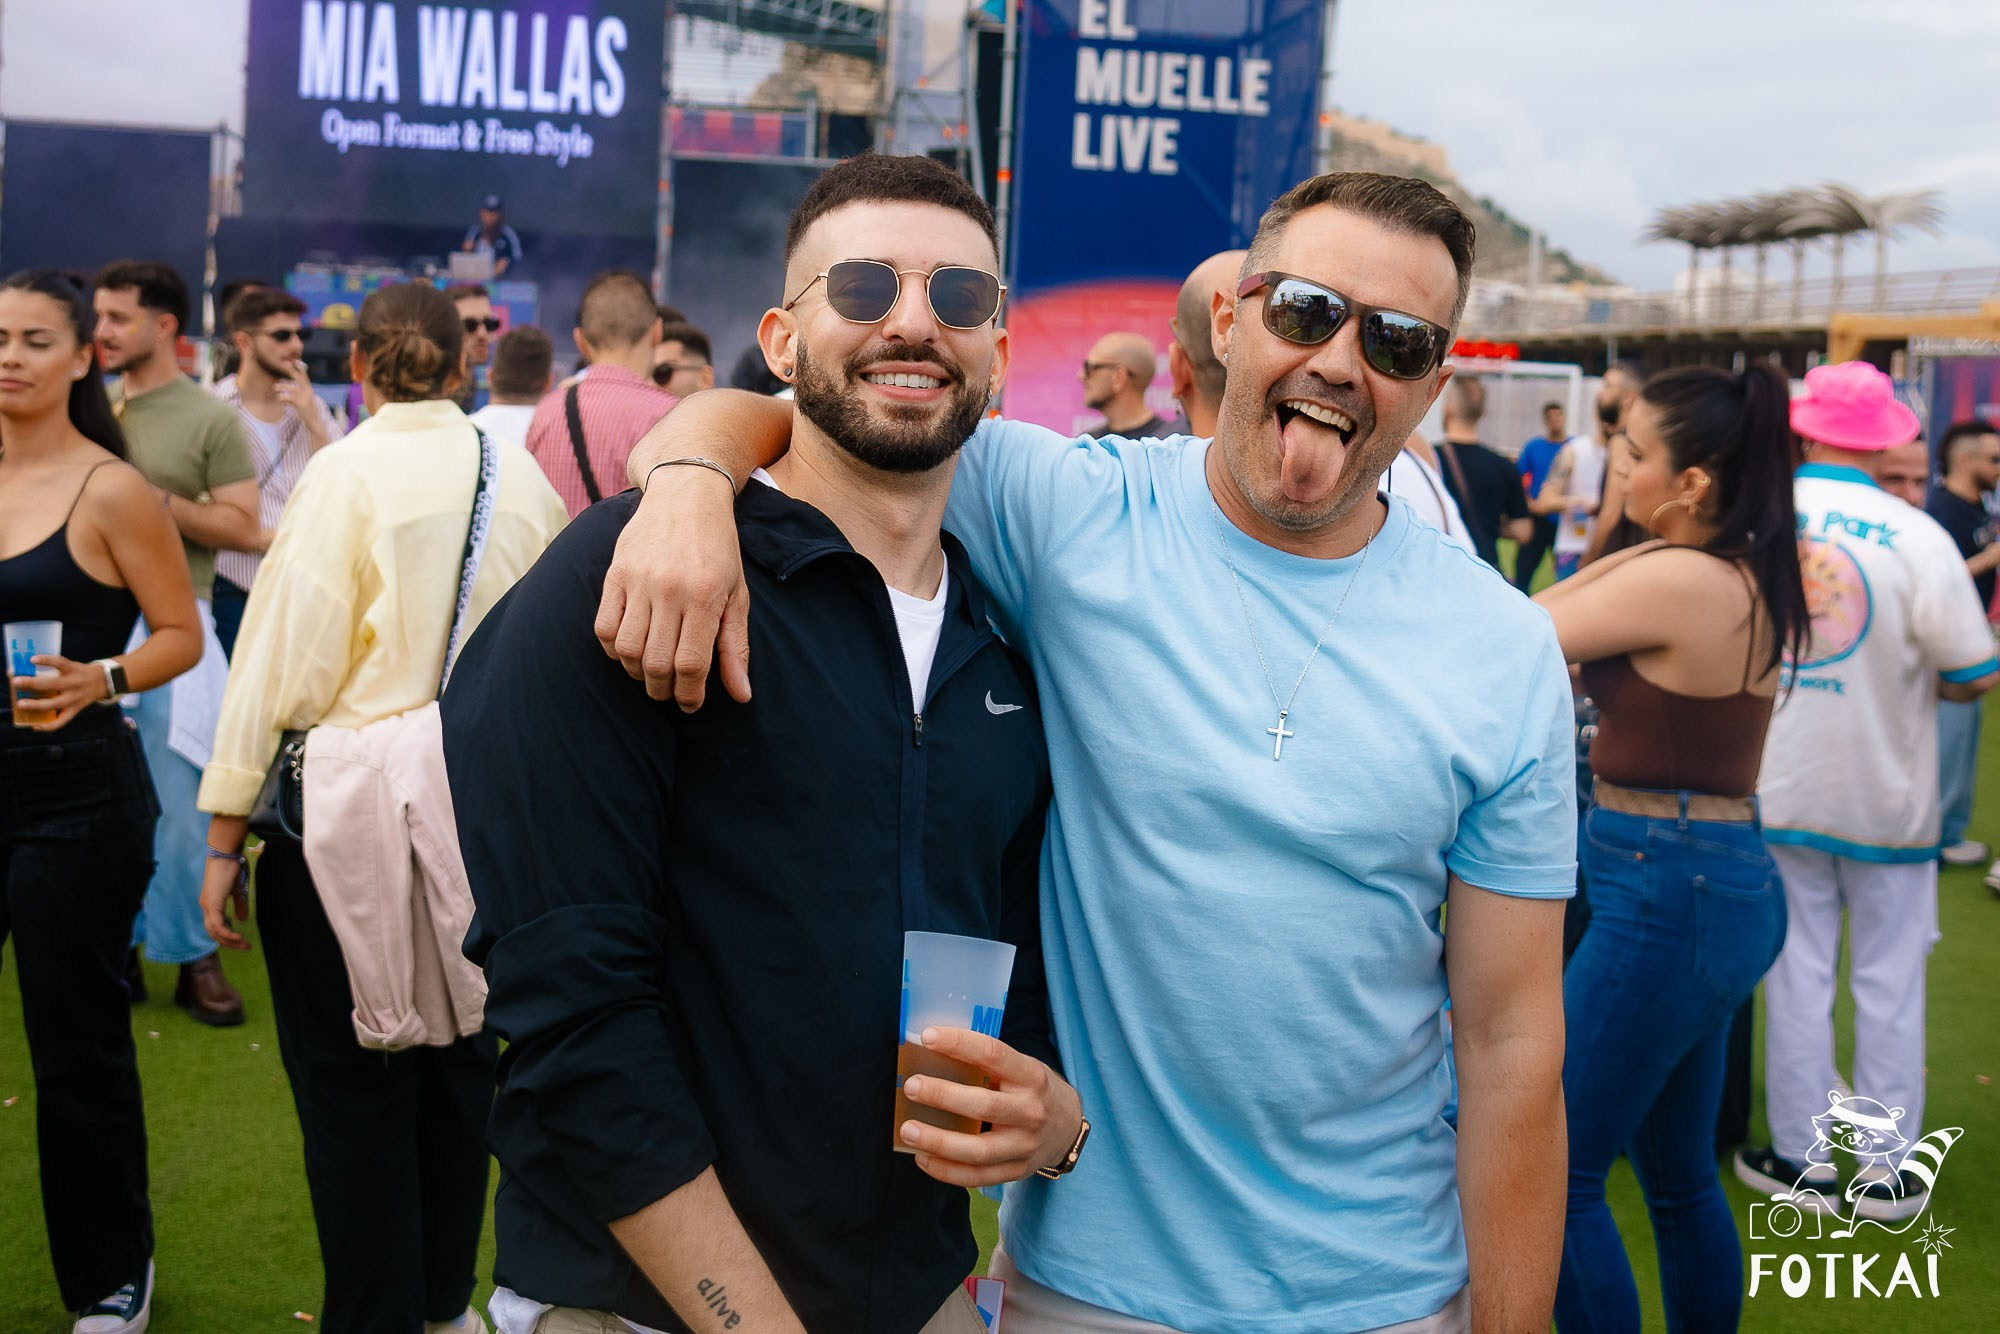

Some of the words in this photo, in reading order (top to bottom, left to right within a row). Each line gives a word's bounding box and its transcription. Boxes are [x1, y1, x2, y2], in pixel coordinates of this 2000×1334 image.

[1078, 0, 1137, 41] EL
[298, 0, 399, 104] MIA
[417, 5, 627, 118] WALLAS
[1075, 46, 1272, 117] MUELLE
[321, 108, 381, 154] Open
[382, 112, 461, 151] Format
[462, 119, 482, 151] &
[484, 118, 534, 154] Free
[535, 120, 594, 167] Style
[1071, 112, 1181, 176] LIVE
[697, 1278, 741, 1329] alive
